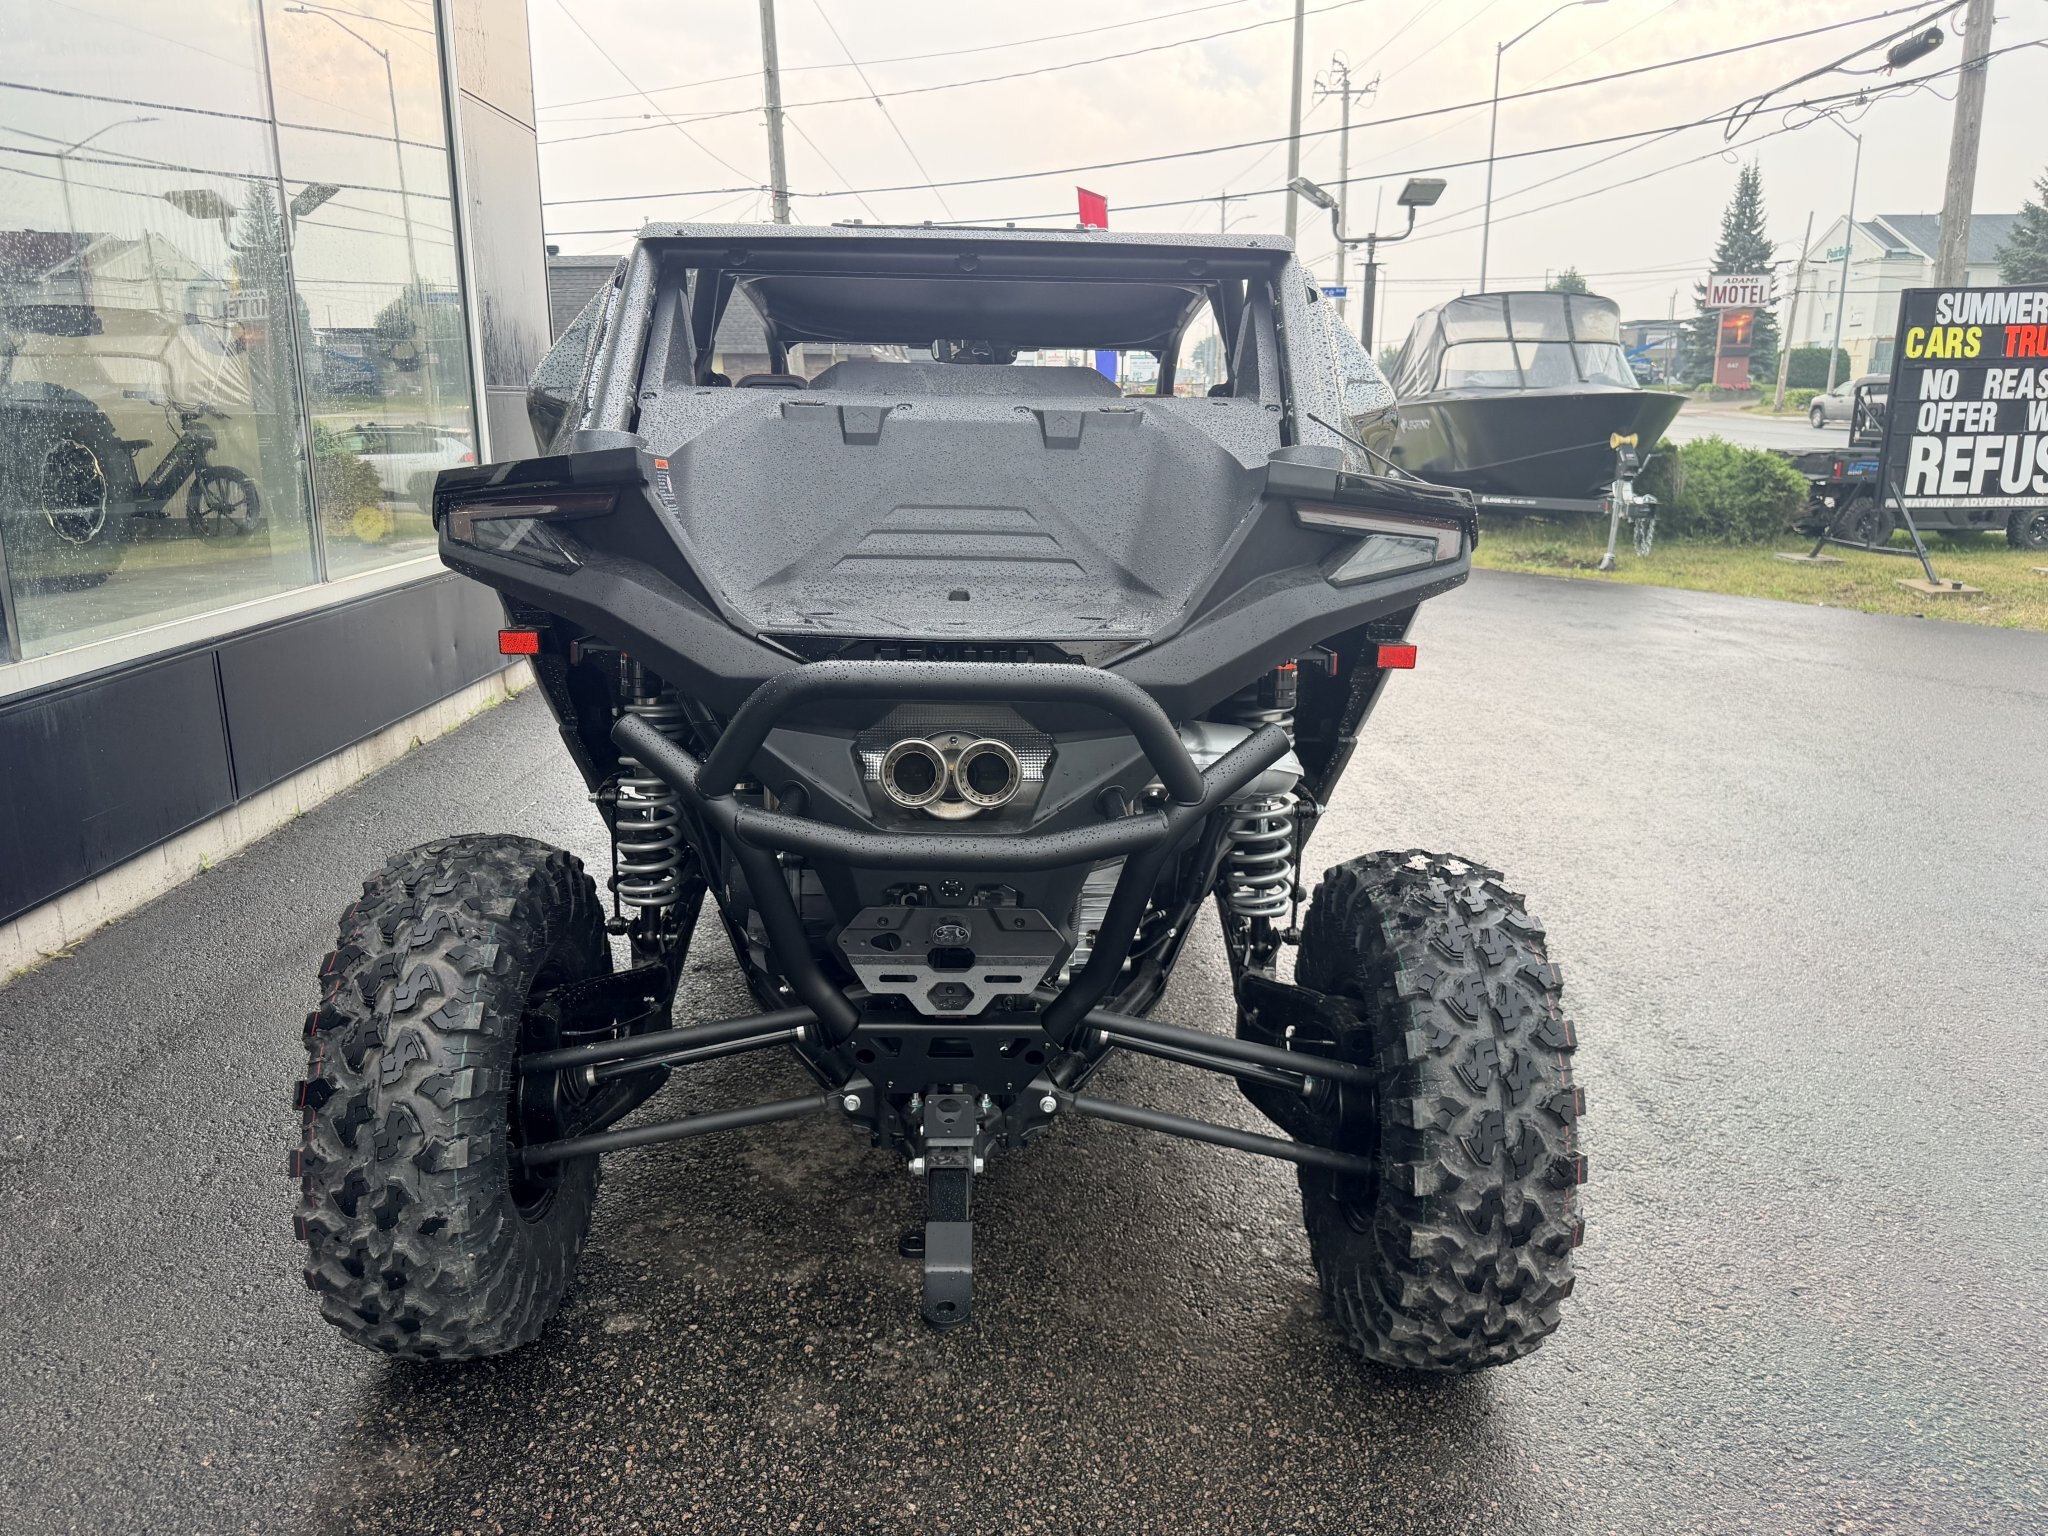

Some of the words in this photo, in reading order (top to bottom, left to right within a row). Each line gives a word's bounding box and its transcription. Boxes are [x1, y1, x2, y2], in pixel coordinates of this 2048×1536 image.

[1712, 285, 1765, 304] MOTEL
[1724, 277, 1759, 285] ADAMS
[1936, 292, 2048, 325] SUMMER
[1905, 326, 1983, 359] CARS
[1919, 368, 1960, 400] NO
[1982, 367, 2048, 400] REAS
[1917, 401, 1998, 433] OFFER
[1905, 498, 1955, 508] BATMAN
[1961, 497, 2044, 508] ADVERTISING
